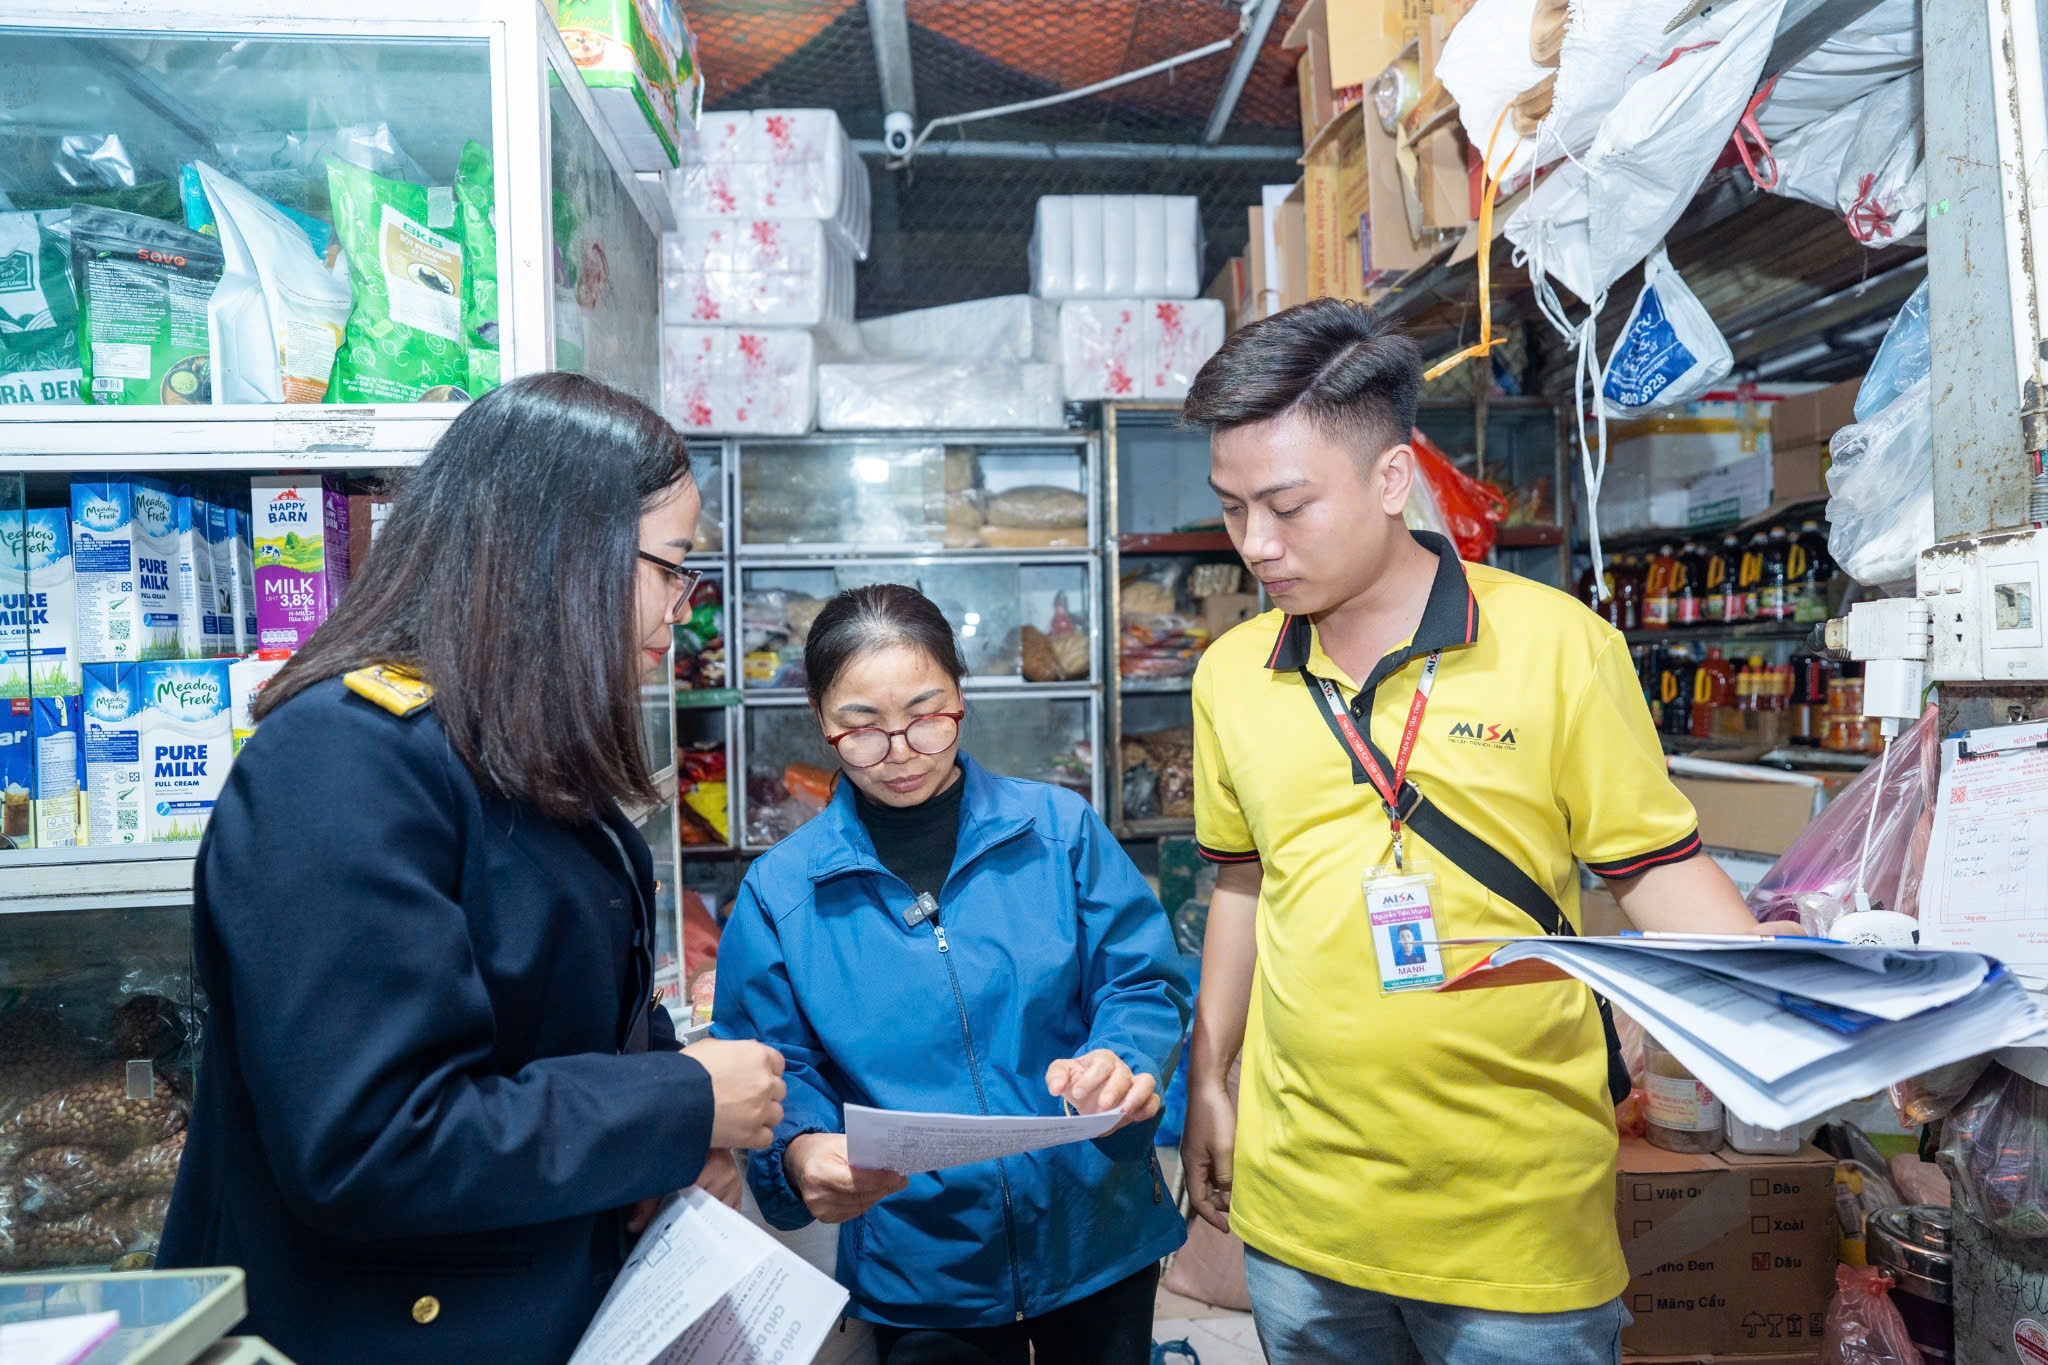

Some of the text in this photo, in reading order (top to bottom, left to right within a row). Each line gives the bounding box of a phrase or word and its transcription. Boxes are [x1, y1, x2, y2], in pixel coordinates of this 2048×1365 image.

[404, 222, 443, 248] BKB
[0, 379, 35, 404] RÀ
[86, 505, 119, 518] Meadow
[136, 495, 170, 515] Meadow
[269, 502, 305, 512] HAPPY
[98, 511, 117, 520] Fresh
[147, 507, 168, 522] Fresh
[268, 511, 308, 524] BARN
[12, 540, 51, 557] Fresh
[138, 558, 168, 575] PURE
[140, 575, 169, 591] MILK
[265, 578, 314, 595] MILK
[280, 594, 315, 608] 3,8%
[157, 678, 218, 704] Meadow
[96, 696, 127, 708] Meadow
[107, 702, 125, 710] Fresh
[179, 691, 216, 709] Fresh
[0, 730, 28, 746] ar
[1449, 722, 1516, 743] MISA
[155, 744, 208, 761] PURE
[154, 760, 208, 777] MILK
[1383, 893, 1415, 905] MISA
[1656, 1188, 1683, 1200] Việt
[1773, 1183, 1800, 1195] Đào
[1774, 1220, 1804, 1231] Xoài
[1688, 1260, 1714, 1271] Đen
[1775, 1256, 1802, 1268] Dâu
